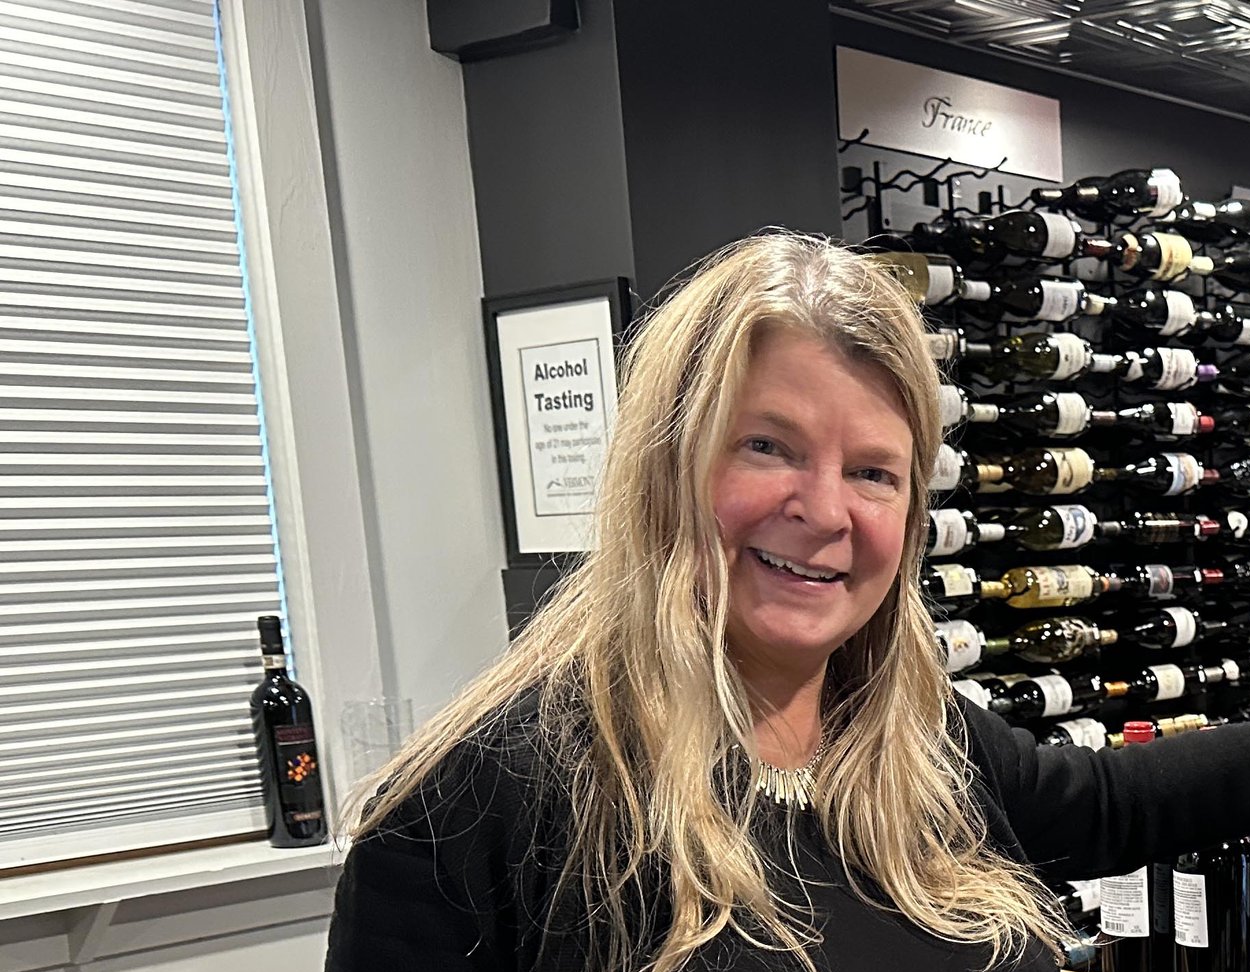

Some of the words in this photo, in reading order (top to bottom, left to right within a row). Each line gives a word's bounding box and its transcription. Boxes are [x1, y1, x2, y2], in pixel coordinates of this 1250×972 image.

[922, 96, 992, 137] France
[534, 358, 588, 381] Alcohol
[534, 390, 594, 411] Tasting
